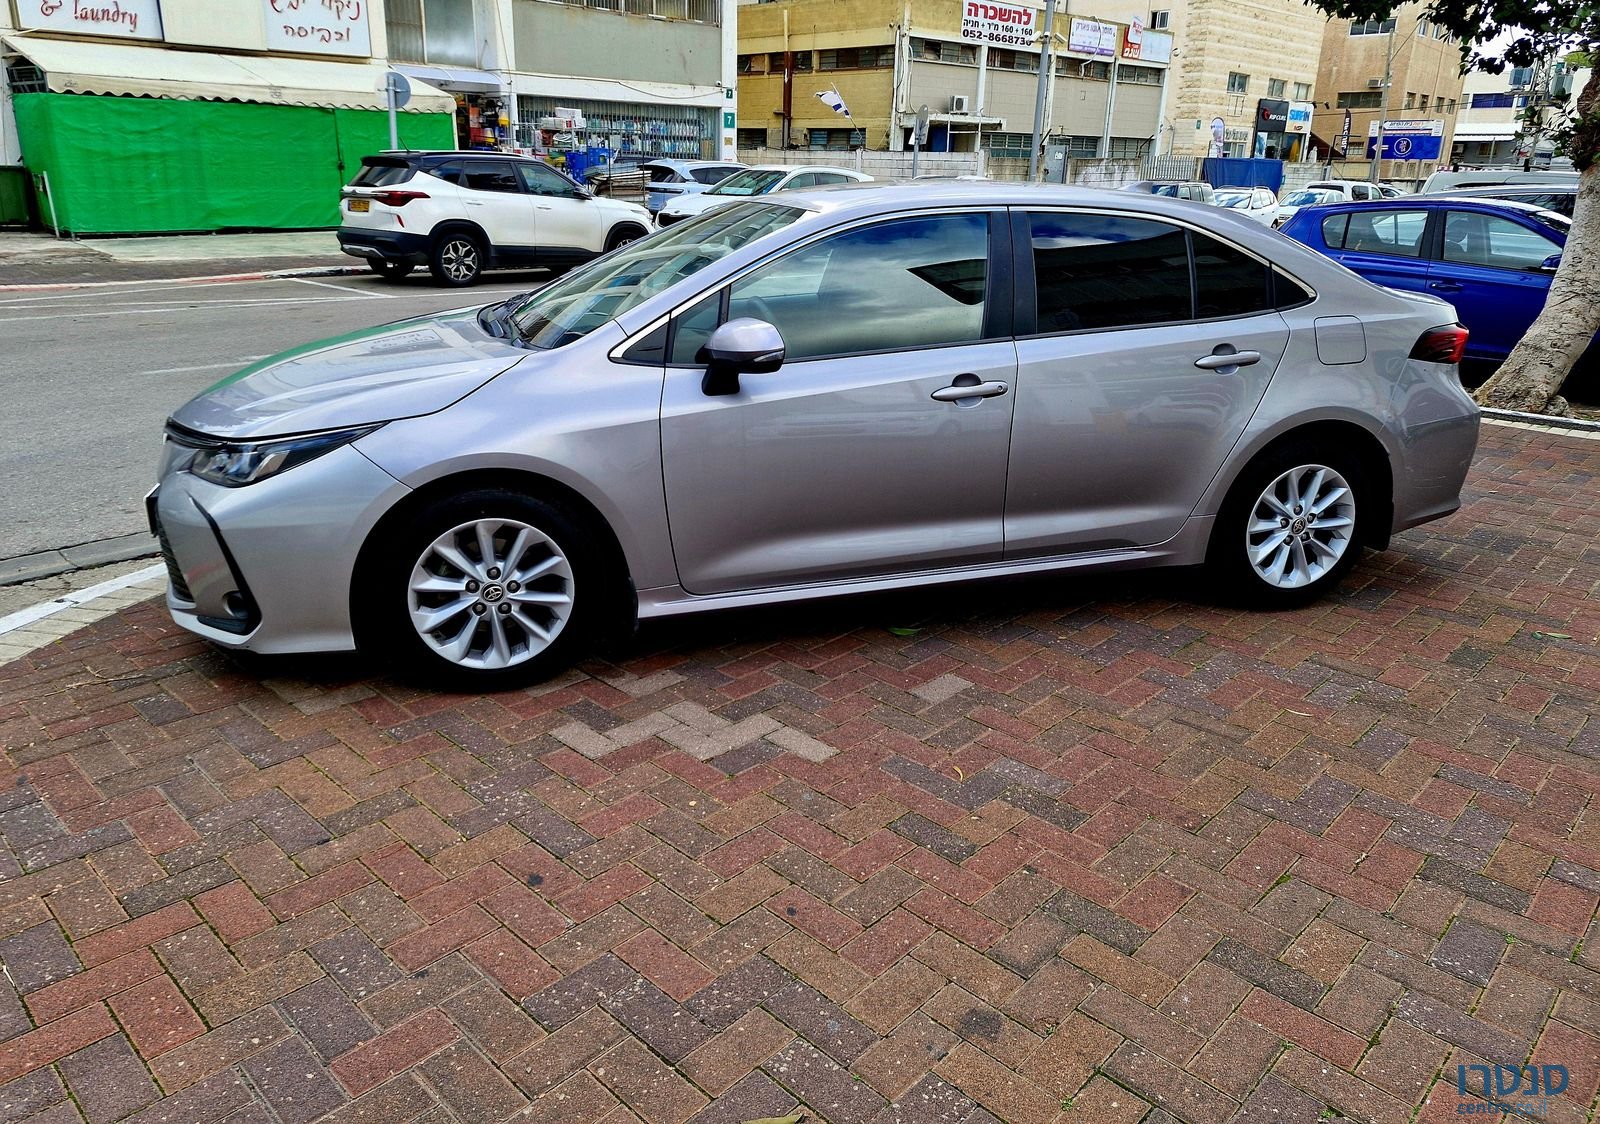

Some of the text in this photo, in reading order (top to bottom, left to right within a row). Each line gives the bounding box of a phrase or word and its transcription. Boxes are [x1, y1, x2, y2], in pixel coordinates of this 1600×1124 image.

[74, 0, 138, 32] laundry
[967, 2, 1032, 26] להשכרה
[963, 18, 980, 28] חניה
[1001, 24, 1014, 33] 160
[283, 25, 350, 43] וכביסה
[1021, 27, 1033, 36] 160
